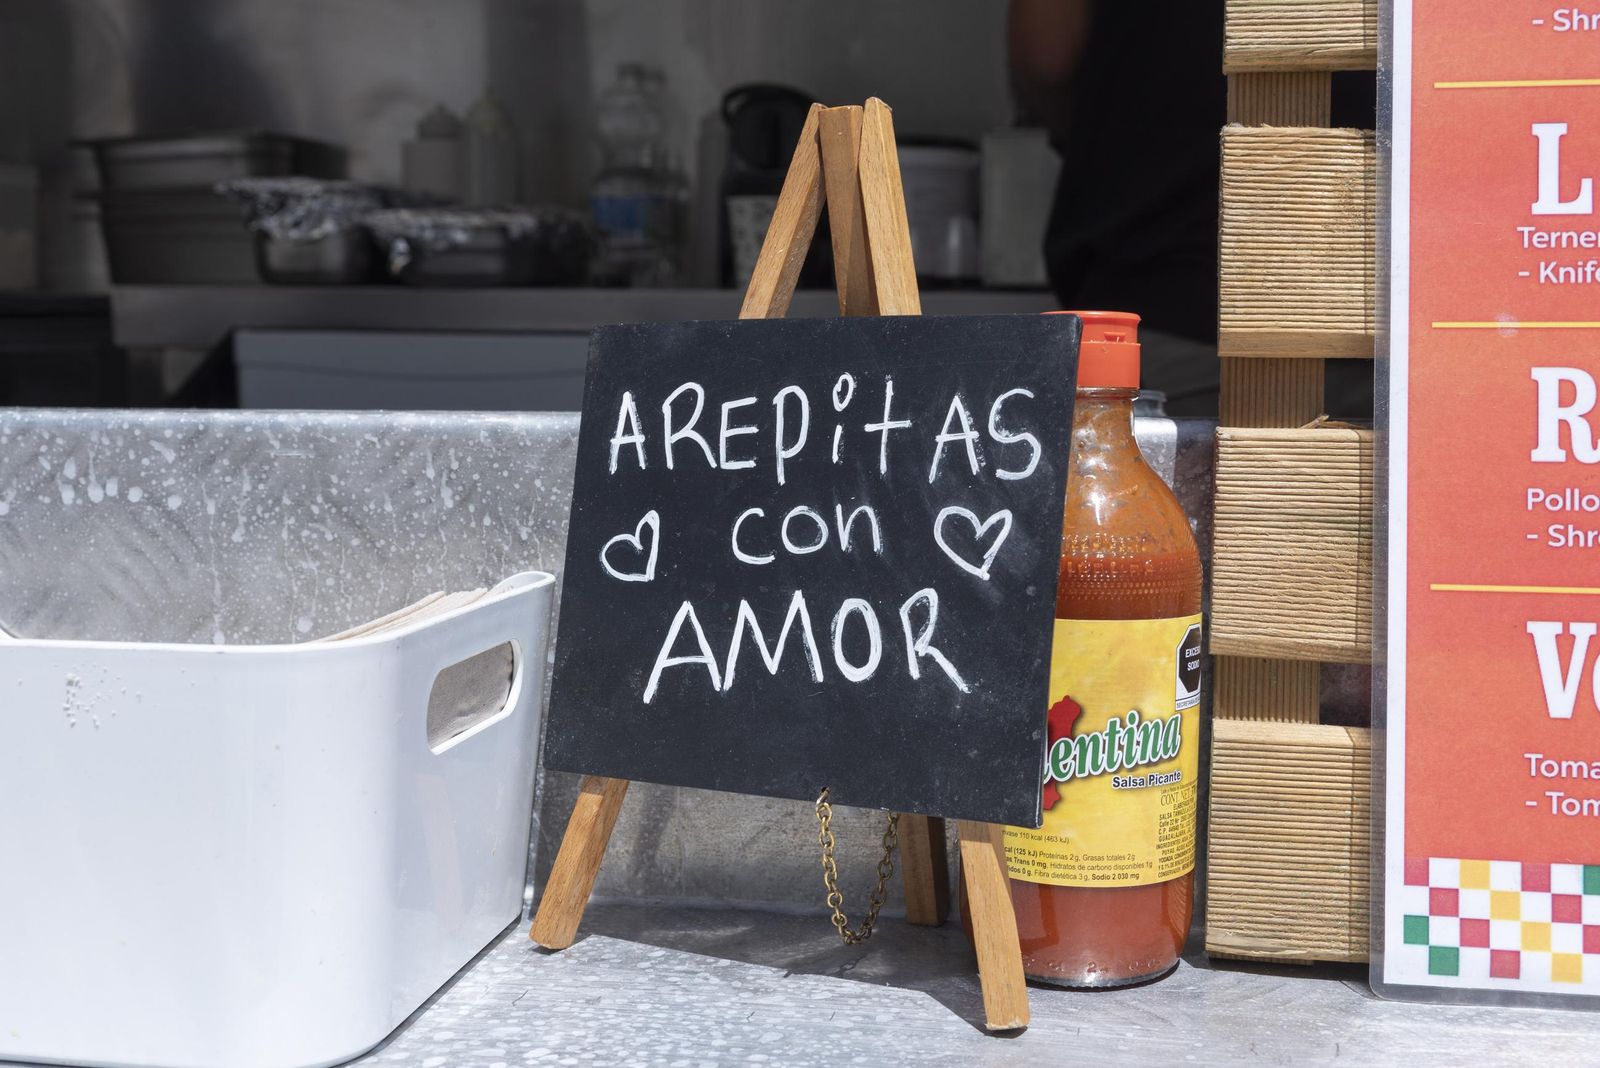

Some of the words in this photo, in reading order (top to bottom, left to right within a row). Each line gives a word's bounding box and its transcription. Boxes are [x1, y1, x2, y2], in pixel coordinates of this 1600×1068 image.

[1531, 122, 1593, 215] L
[1516, 226, 1600, 248] Terne
[1530, 366, 1600, 464] R
[1527, 487, 1600, 512] Pollo
[1547, 523, 1600, 548] Shr
[643, 587, 972, 703] AMOR
[1526, 620, 1600, 719] V
[1112, 776, 1145, 789] Salsa
[1148, 770, 1182, 786] Picante
[1031, 833, 1043, 841] kcal
[1013, 847, 1026, 856] (125
[1028, 849, 1038, 858] kJ)
[1083, 853, 1105, 861] Grasas
[1106, 853, 1126, 861] totales
[1014, 856, 1031, 866] Trans
[1050, 862, 1077, 871] Hidratos
[1113, 861, 1145, 872] disponibles
[1034, 869, 1050, 878] Fibra
[1091, 873, 1111, 881] Sodio
[1130, 872, 1140, 881] mg
